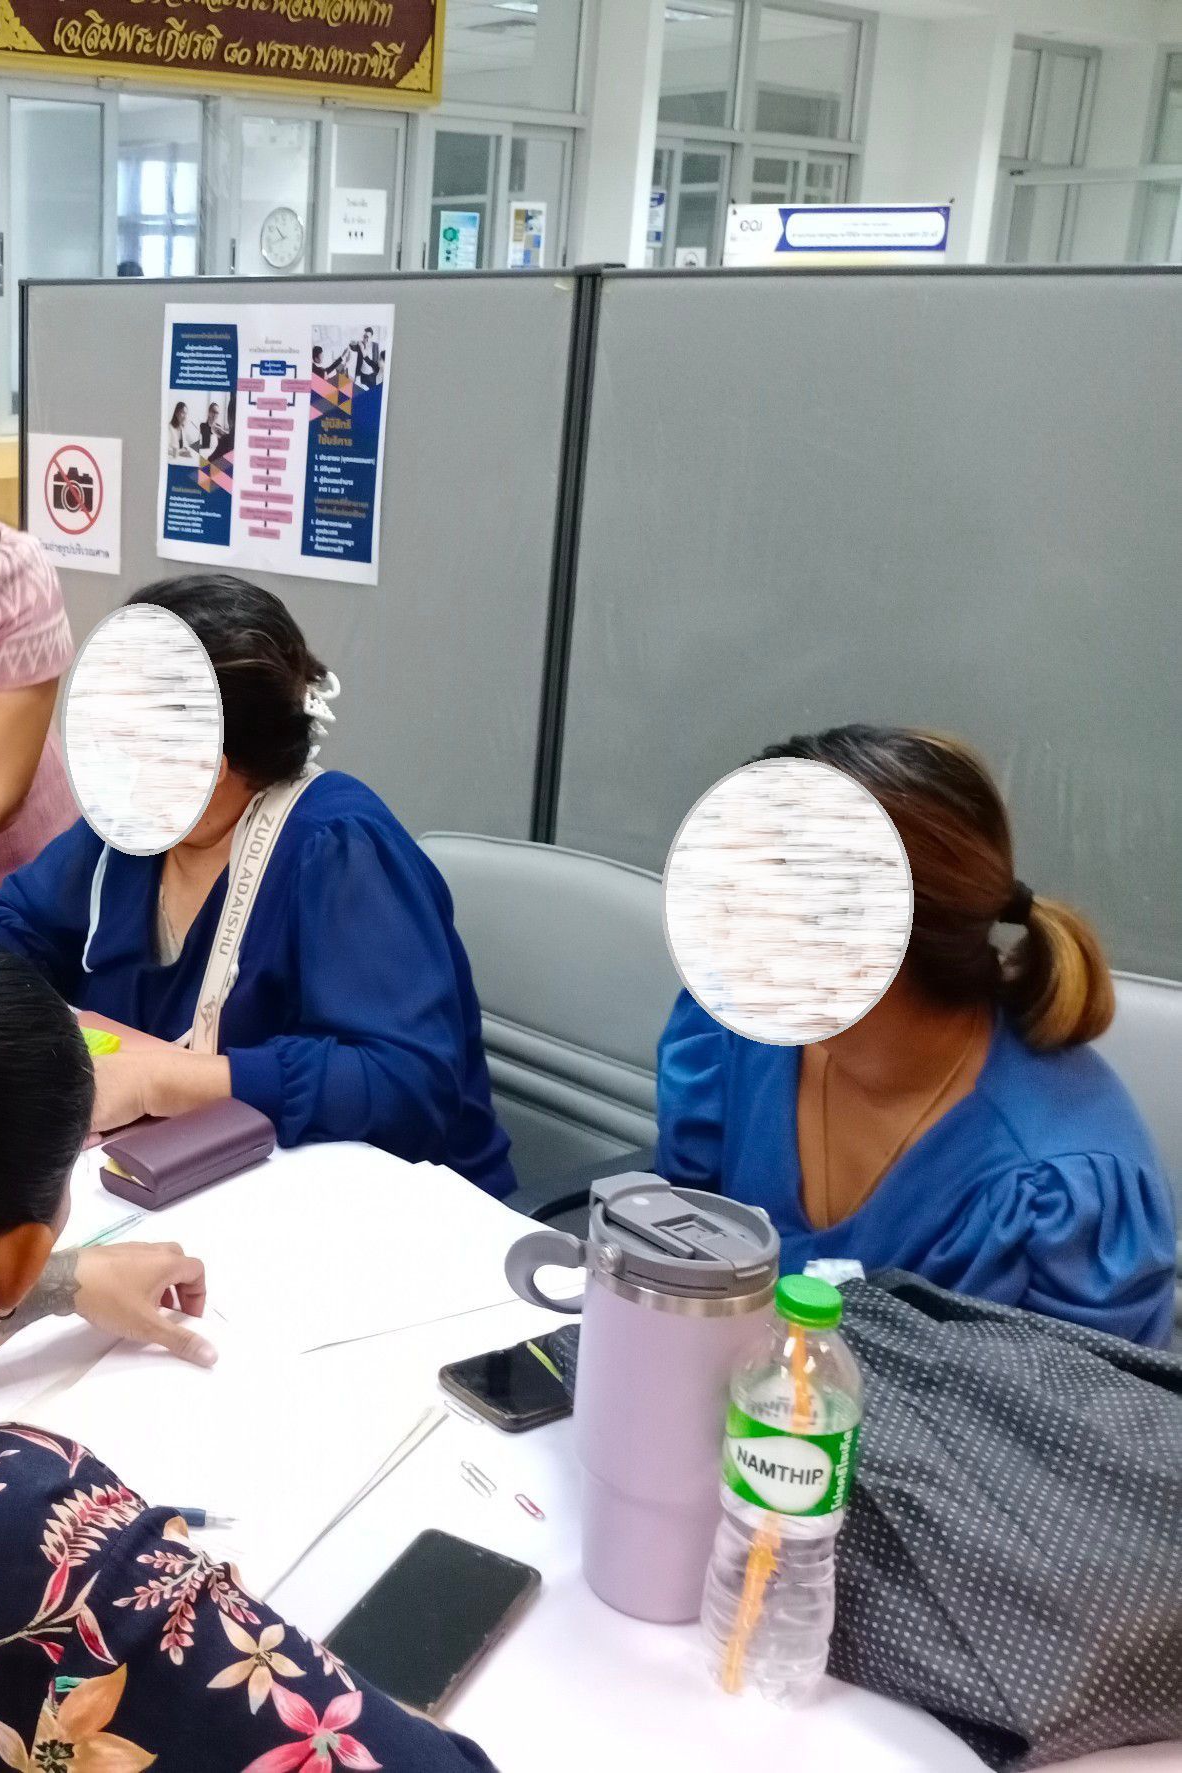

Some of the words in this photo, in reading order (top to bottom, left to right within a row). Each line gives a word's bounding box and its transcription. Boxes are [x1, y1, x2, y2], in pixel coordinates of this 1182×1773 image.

[53, 9, 223, 62] เฉลิมพระเกียรติ
[254, 40, 405, 80] พรรษามหาราชินี
[218, 812, 276, 957] ZUOLADAISHU
[736, 1446, 824, 1486] NAMTHIP
